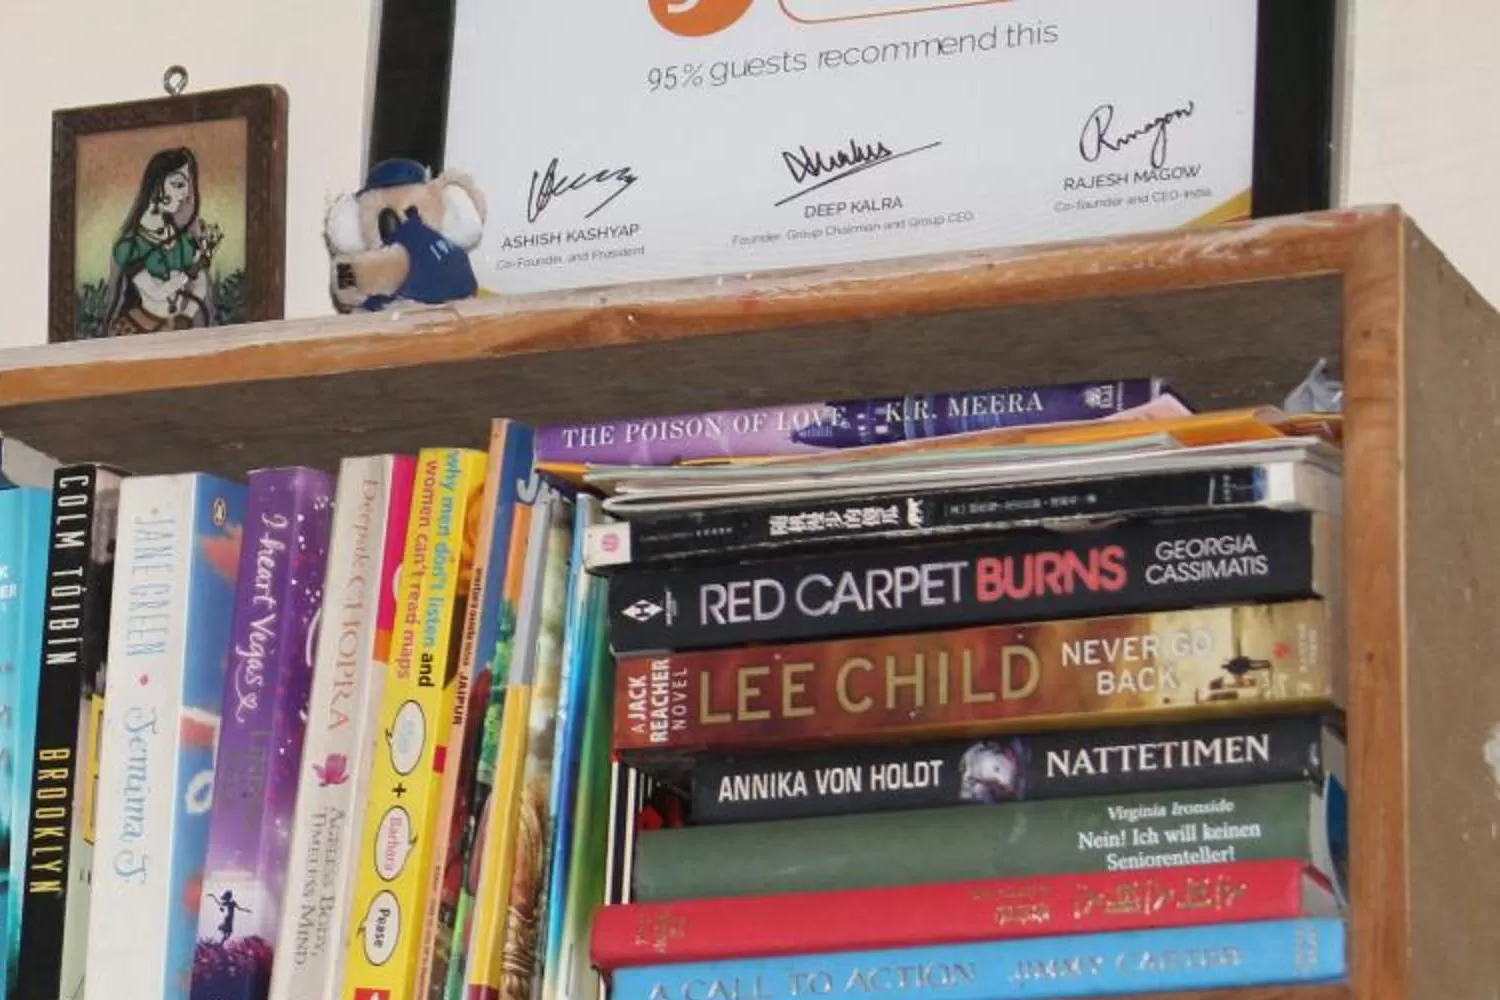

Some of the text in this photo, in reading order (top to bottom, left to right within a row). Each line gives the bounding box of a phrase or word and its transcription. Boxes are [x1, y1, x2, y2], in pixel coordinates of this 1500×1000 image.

[646, 20, 1060, 94] 95% guests recommend this
[1063, 163, 1201, 191] RAJESH MAGOW
[804, 195, 903, 219] DEEP KALRA
[501, 223, 640, 251] ASHISH KASHYAP
[825, 220, 881, 238] Chairman
[884, 218, 905, 231] and
[909, 213, 945, 231] Group
[947, 211, 975, 225] CEO
[561, 426, 615, 449] THE
[624, 416, 723, 444] POISON
[732, 414, 770, 434] OF
[776, 405, 847, 432] LOVE
[947, 391, 1044, 418] MEERA
[54, 475, 89, 550] COLM
[1154, 533, 1258, 563] GEORGIA
[700, 544, 1128, 626] RED CARPET BURNS
[1145, 554, 1269, 586] CASSIMATIS
[1061, 628, 1214, 668] NEVER GO
[699, 642, 1042, 724] LEE CHILD
[1096, 665, 1178, 696] BACK
[718, 733, 1270, 802] ANNIKA VON HOLDT NATTETIMEN
[29, 748, 71, 893] BROOKLYN
[1078, 822, 1262, 850] Nein! Ich will keinen
[1106, 845, 1237, 872] Seniorenteller!
